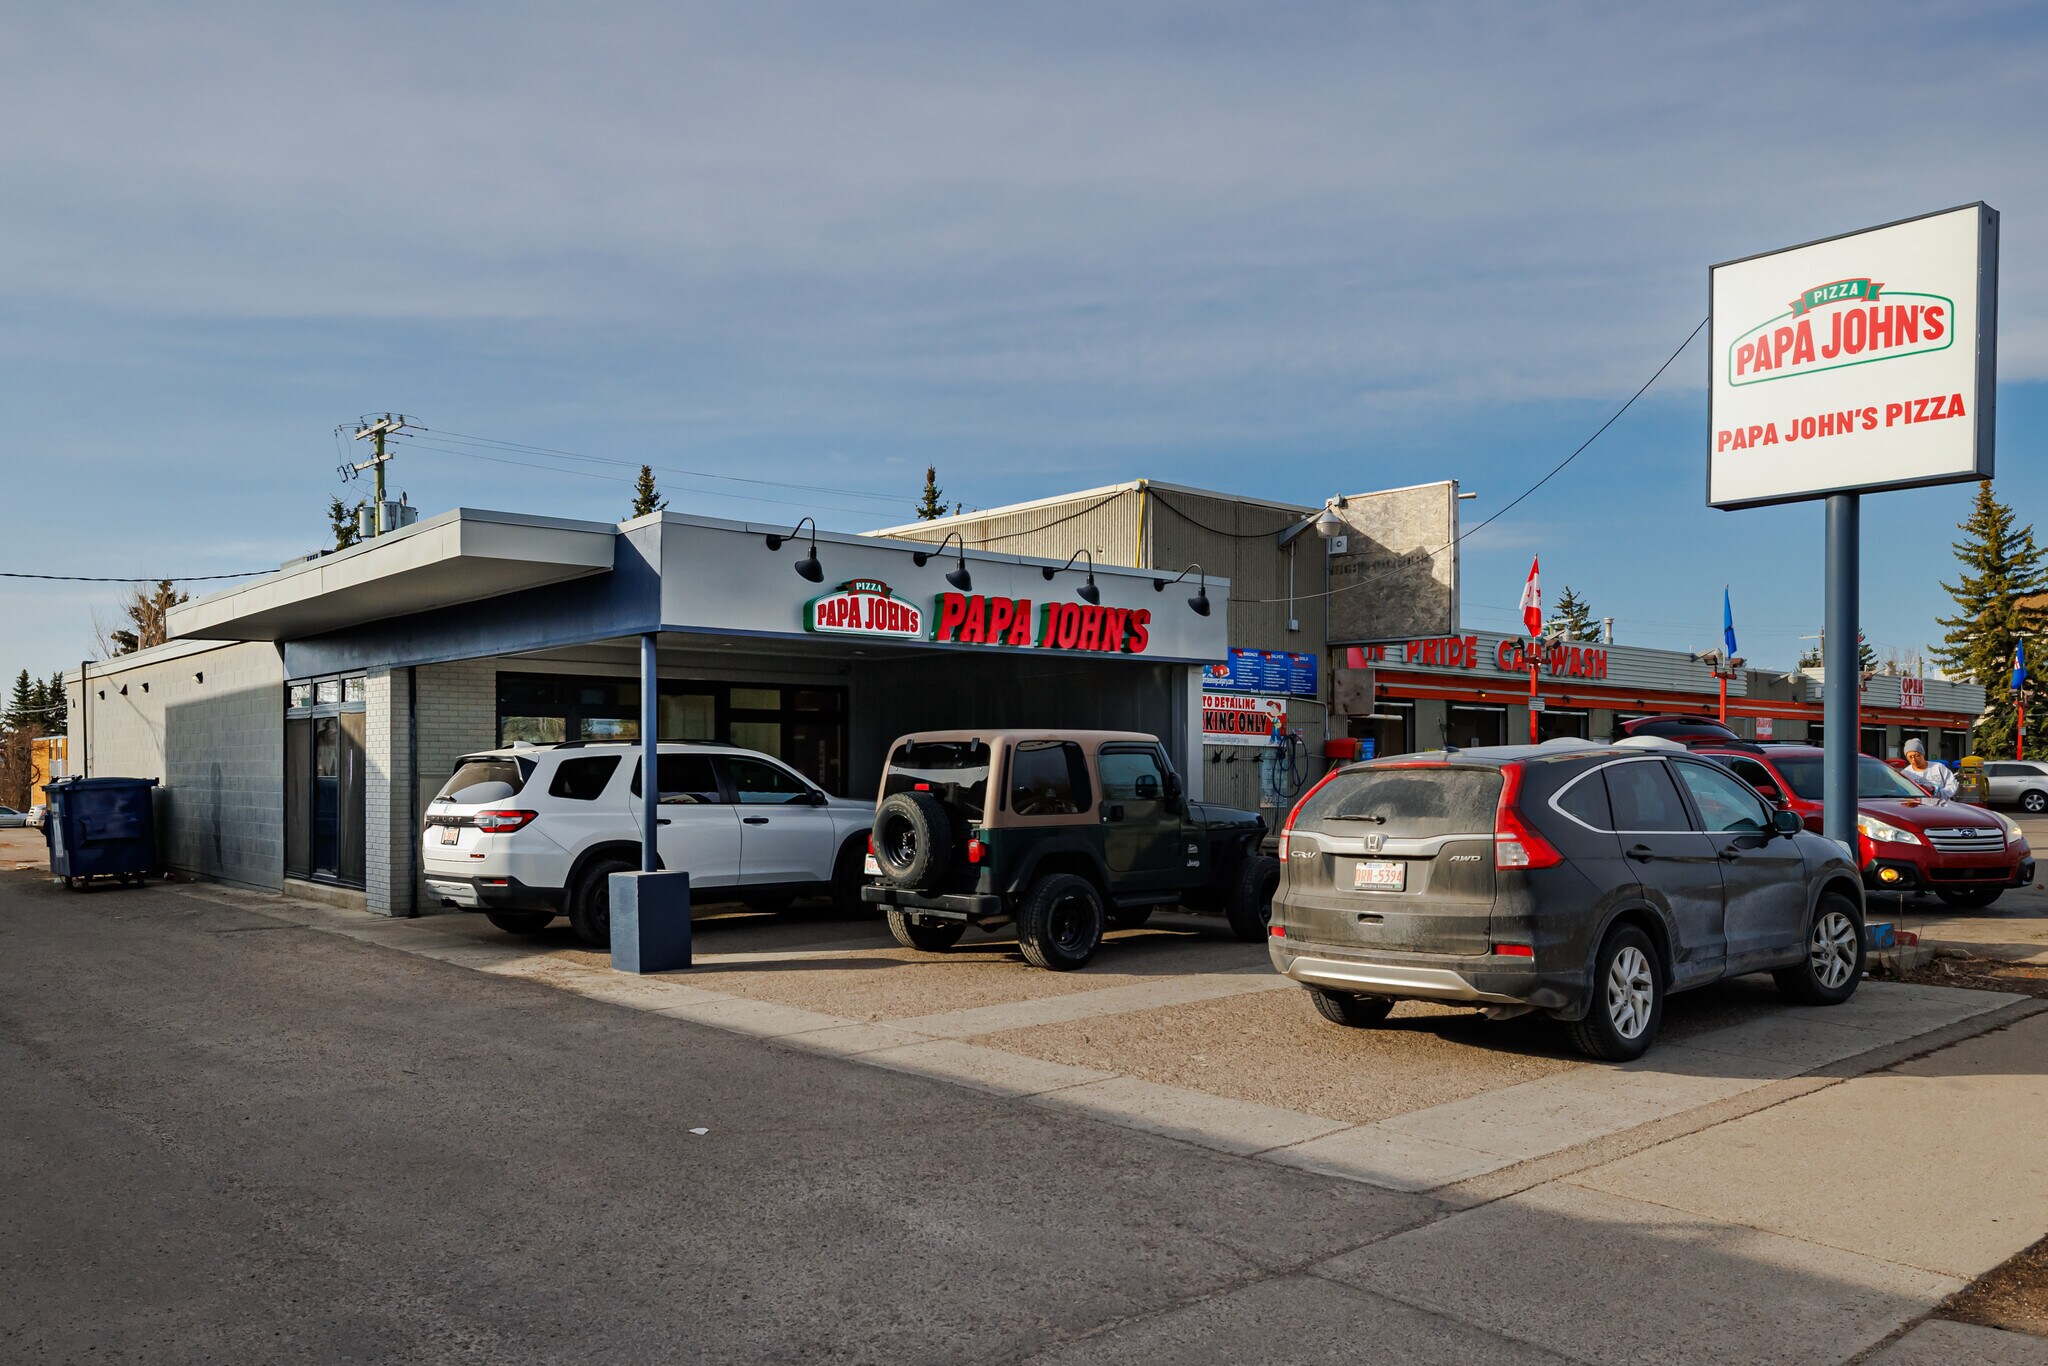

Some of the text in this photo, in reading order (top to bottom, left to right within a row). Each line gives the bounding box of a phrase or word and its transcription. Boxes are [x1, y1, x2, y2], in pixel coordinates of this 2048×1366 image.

[1813, 282, 1859, 303] PIZZA
[1736, 304, 1945, 377] PAPA JOHN'S
[1717, 393, 1966, 453] PAPA JOHN'S PIZZA
[854, 581, 883, 593] PIZZA
[817, 597, 862, 630] PAPA
[934, 592, 1152, 654] PAPA JOHN'S
[1406, 635, 1478, 669] PRIDE
[1550, 645, 1608, 680] WASH
[1902, 677, 1923, 695] OPEN
[1214, 696, 1256, 710] DETAILING
[1900, 695, 1925, 707] 24 HRS
[1203, 711, 1267, 732] KING ONLY
[1186, 859, 1200, 867] Jeep
